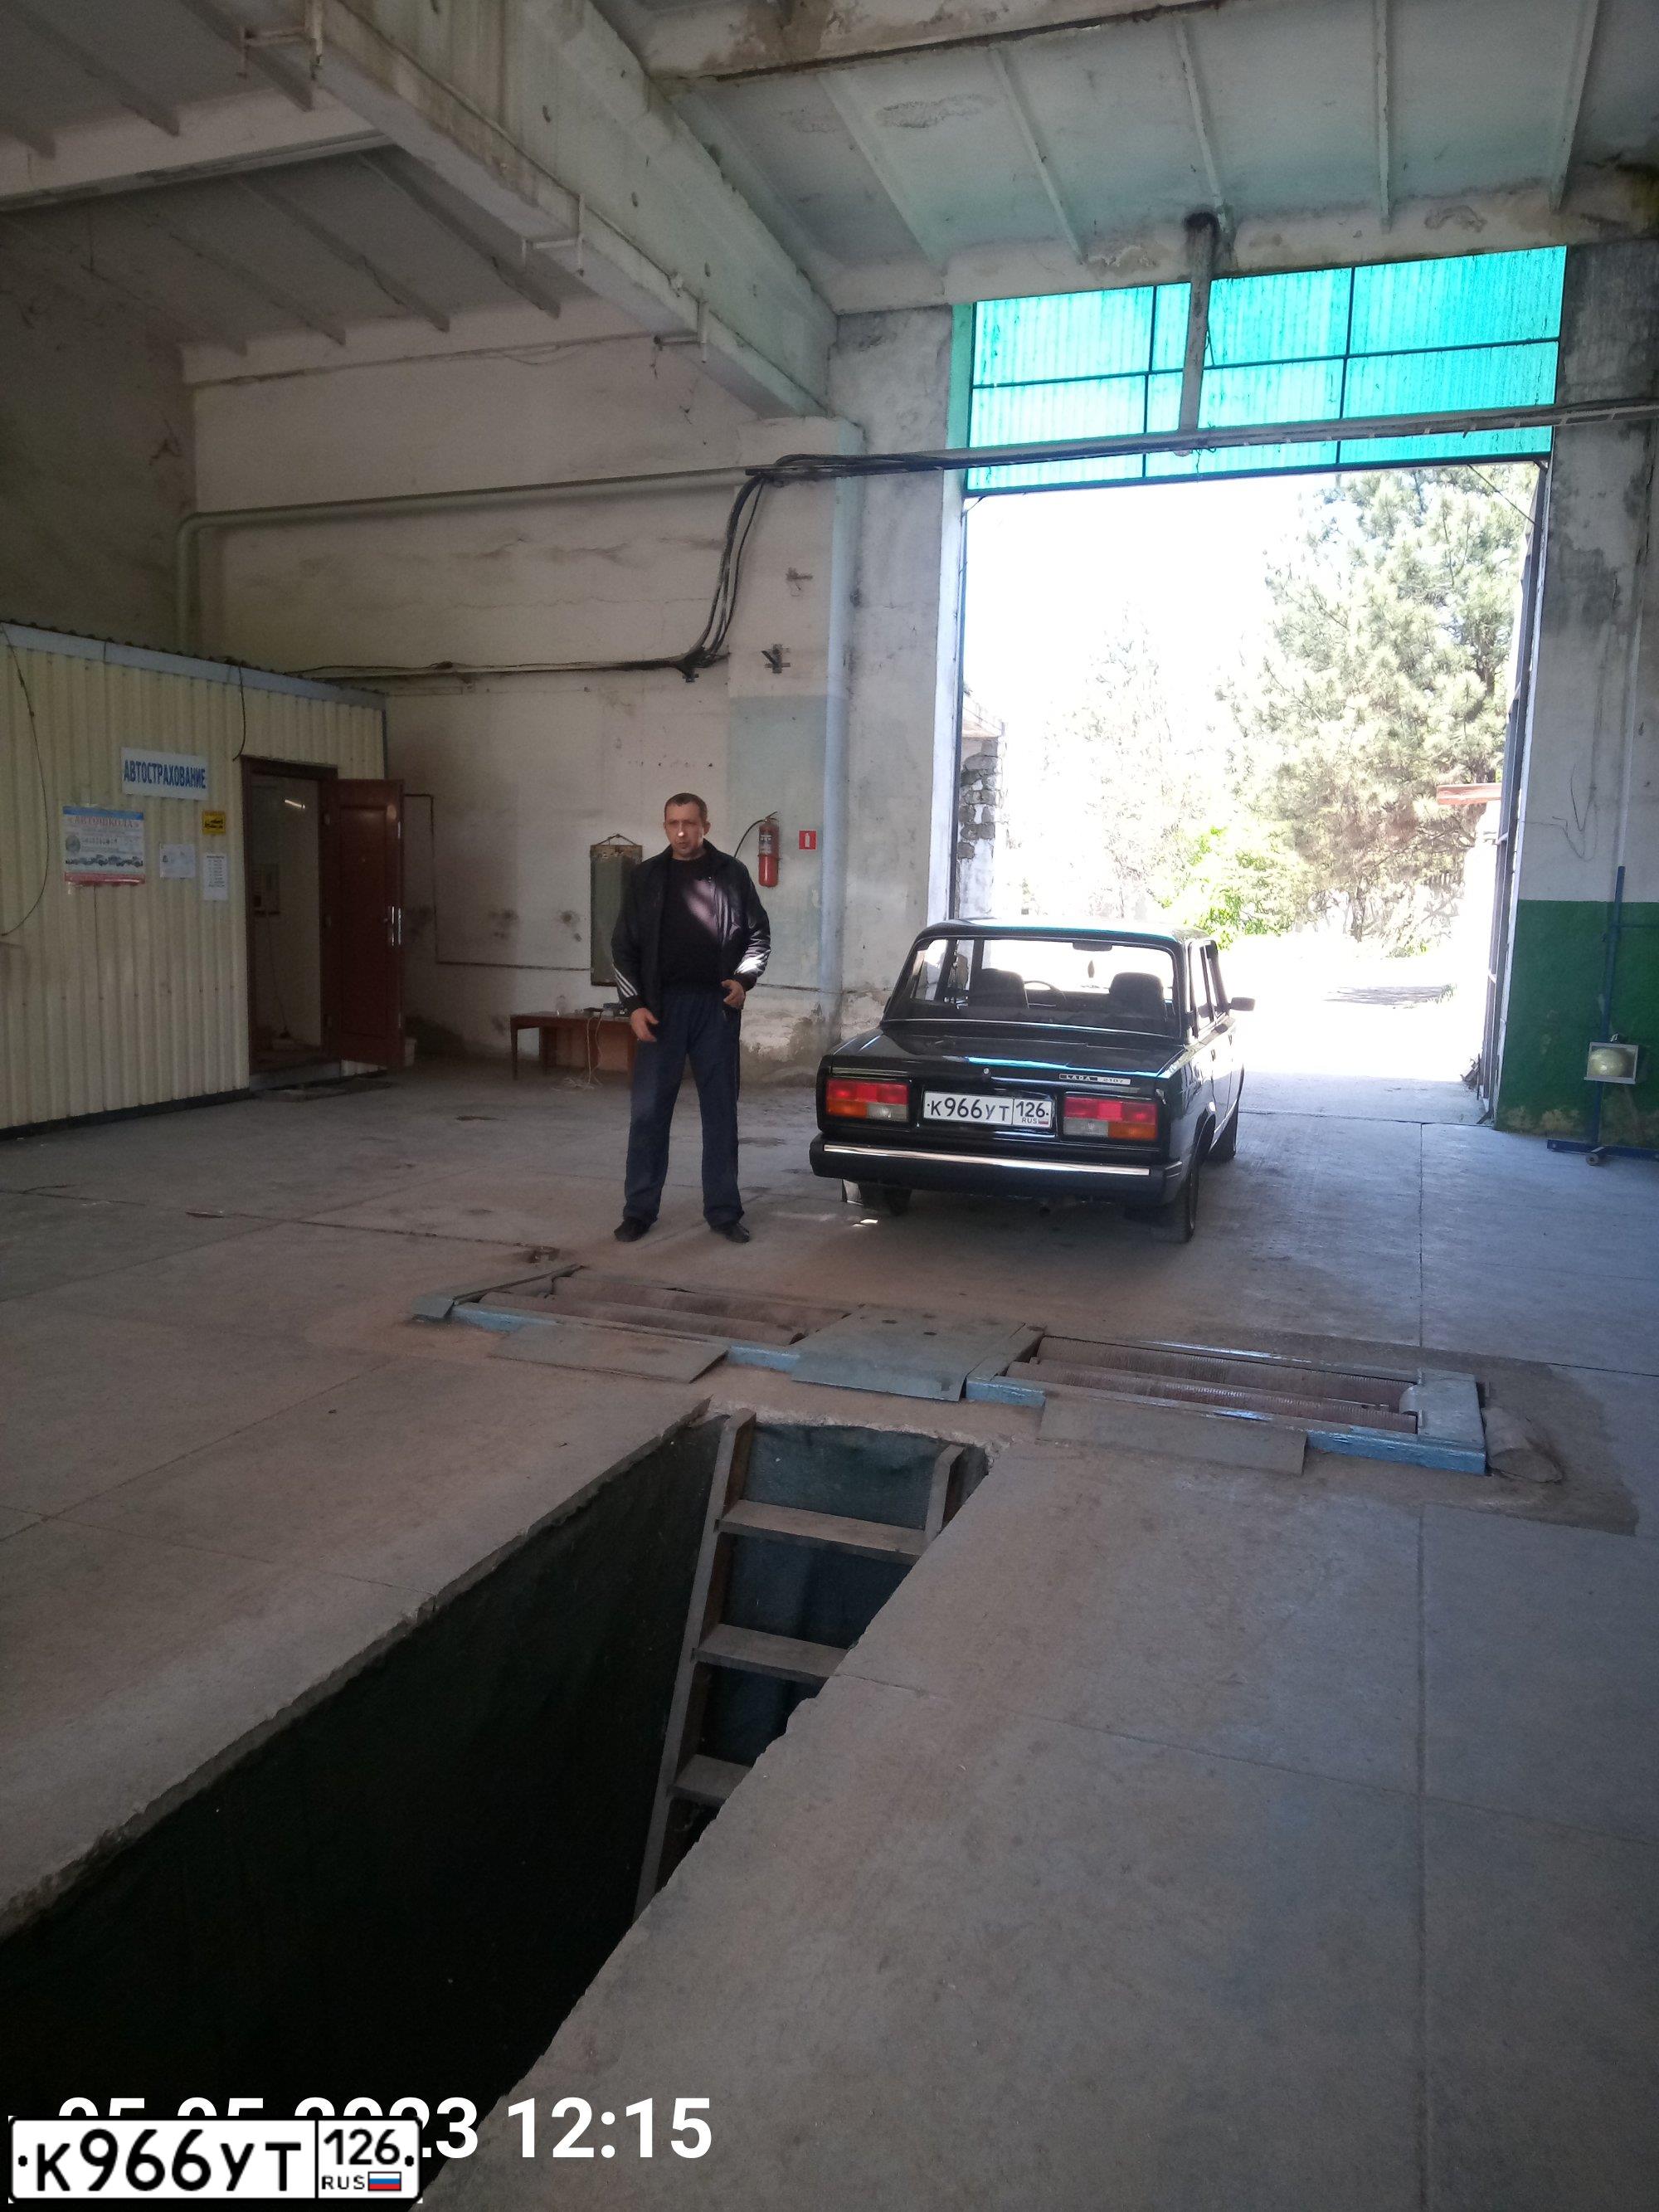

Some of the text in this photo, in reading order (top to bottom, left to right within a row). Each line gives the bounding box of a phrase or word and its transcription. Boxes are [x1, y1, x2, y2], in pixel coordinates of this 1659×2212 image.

[124, 759, 206, 789] АВТОСТРАХОВАНИЕ
[931, 1098, 1045, 1122] К966УТ 126
